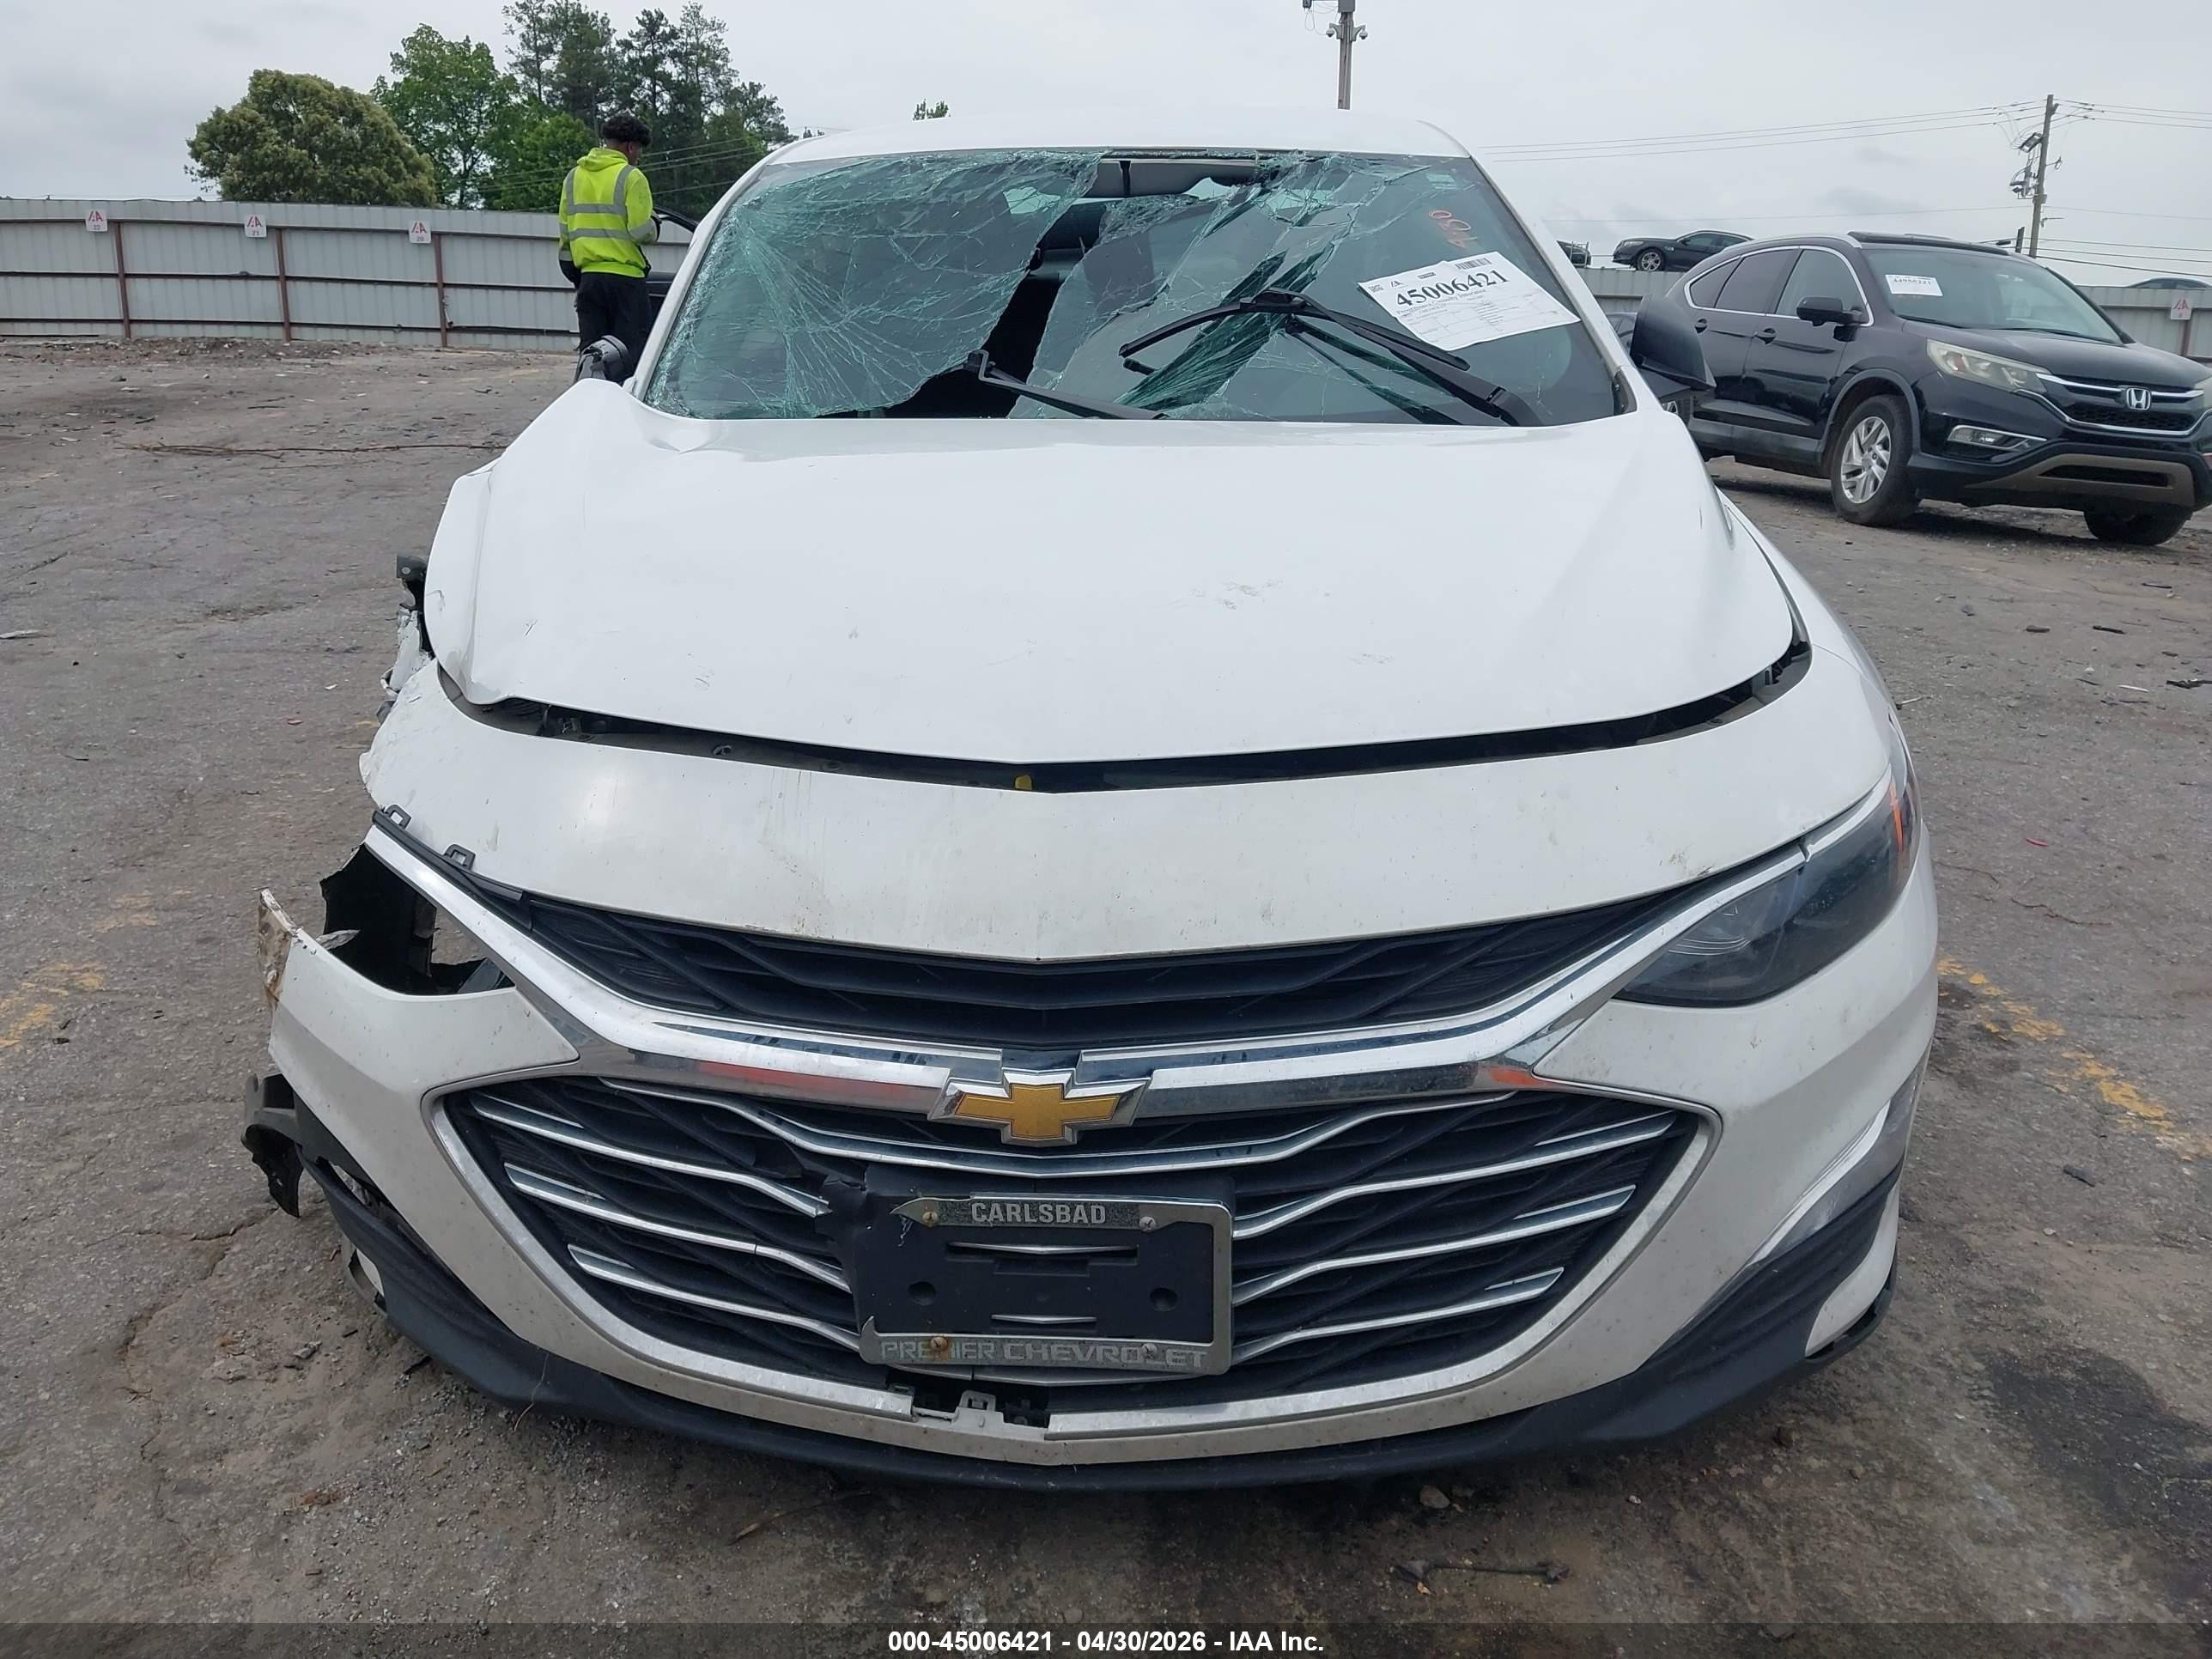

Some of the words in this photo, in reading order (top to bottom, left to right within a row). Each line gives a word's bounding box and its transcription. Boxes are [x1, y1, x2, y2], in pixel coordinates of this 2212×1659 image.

[1396, 270, 1510, 307] 45006421
[971, 1202, 1106, 1224] CARLSBAD
[881, 1340, 995, 1360] PREIER
